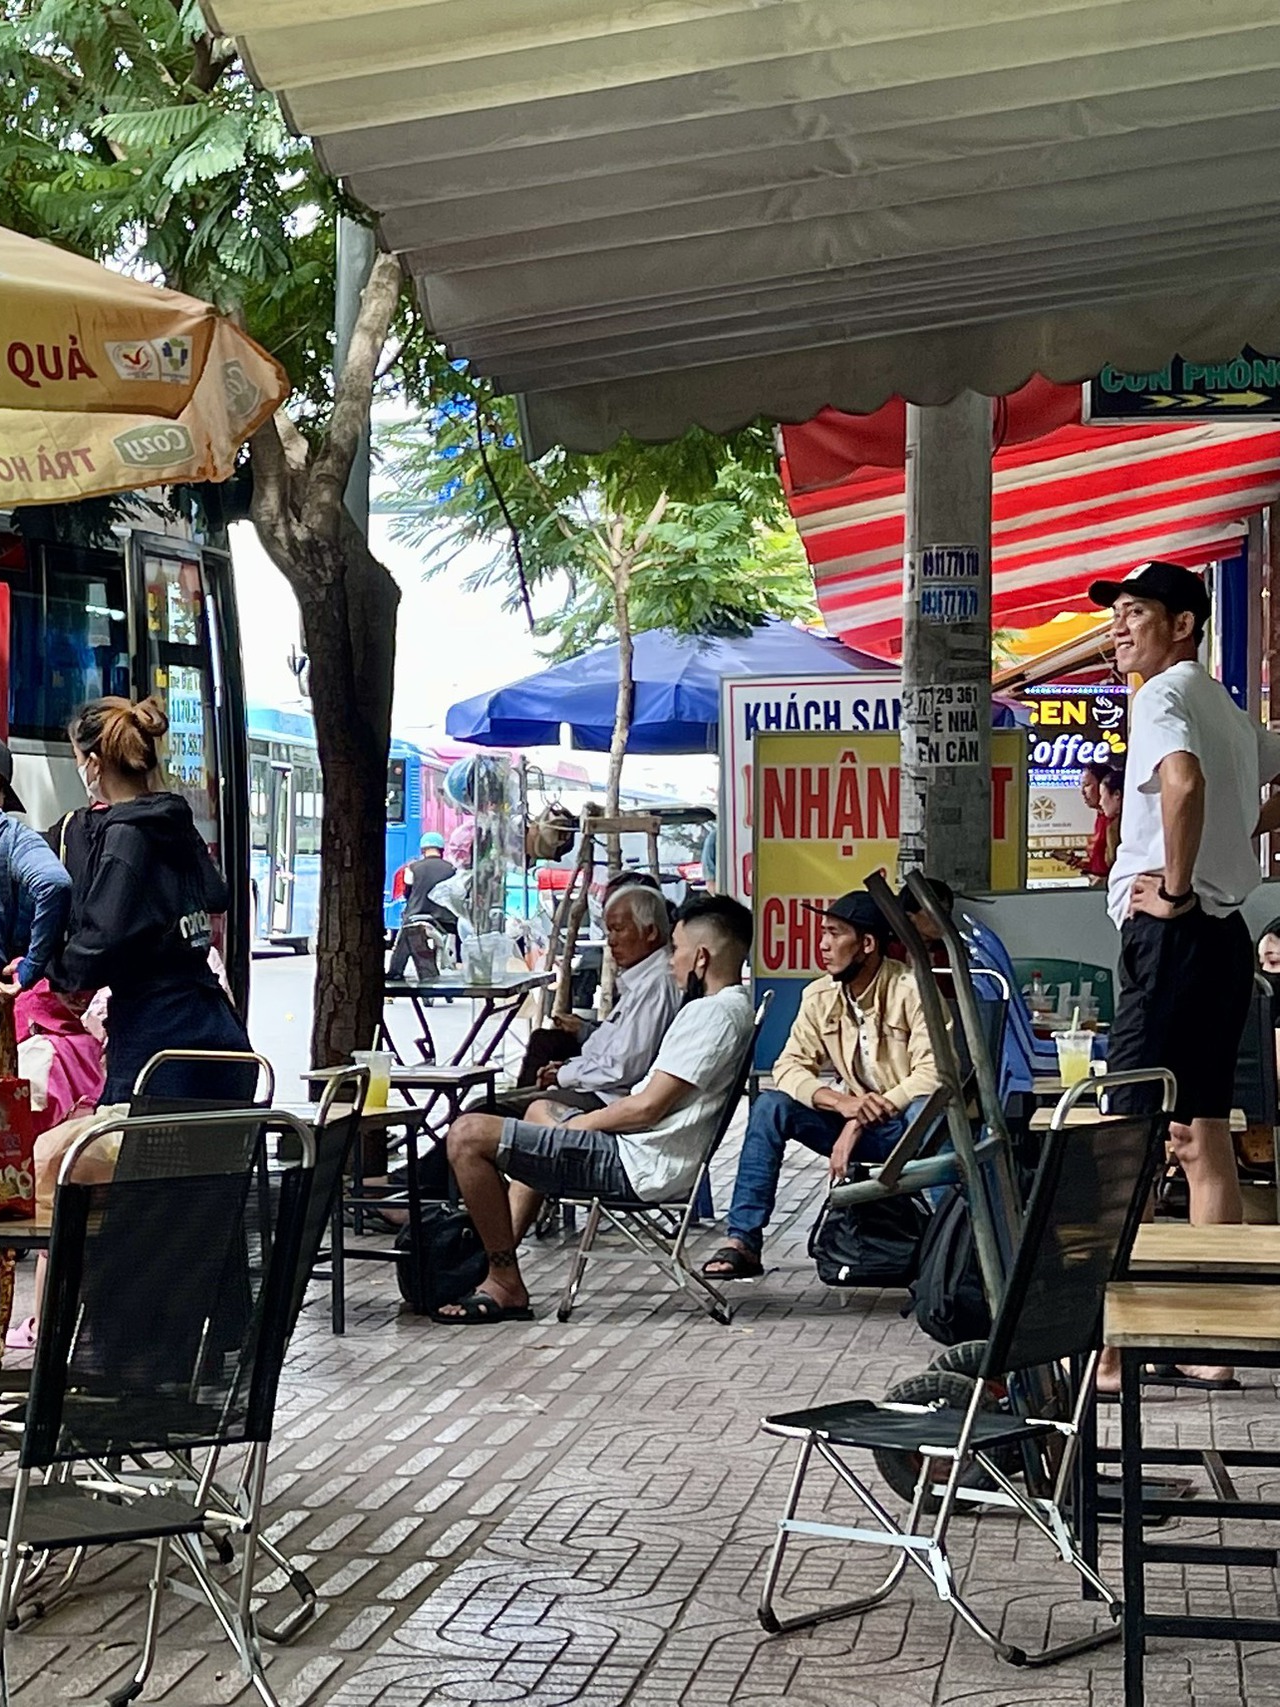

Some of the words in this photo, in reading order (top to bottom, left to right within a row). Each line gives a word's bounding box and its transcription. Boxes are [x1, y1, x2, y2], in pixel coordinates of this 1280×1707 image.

[7, 334, 98, 388] QUẢ
[745, 693, 842, 741] KHÁCH
[1028, 733, 1109, 767] offee
[763, 751, 900, 856] NHẬN
